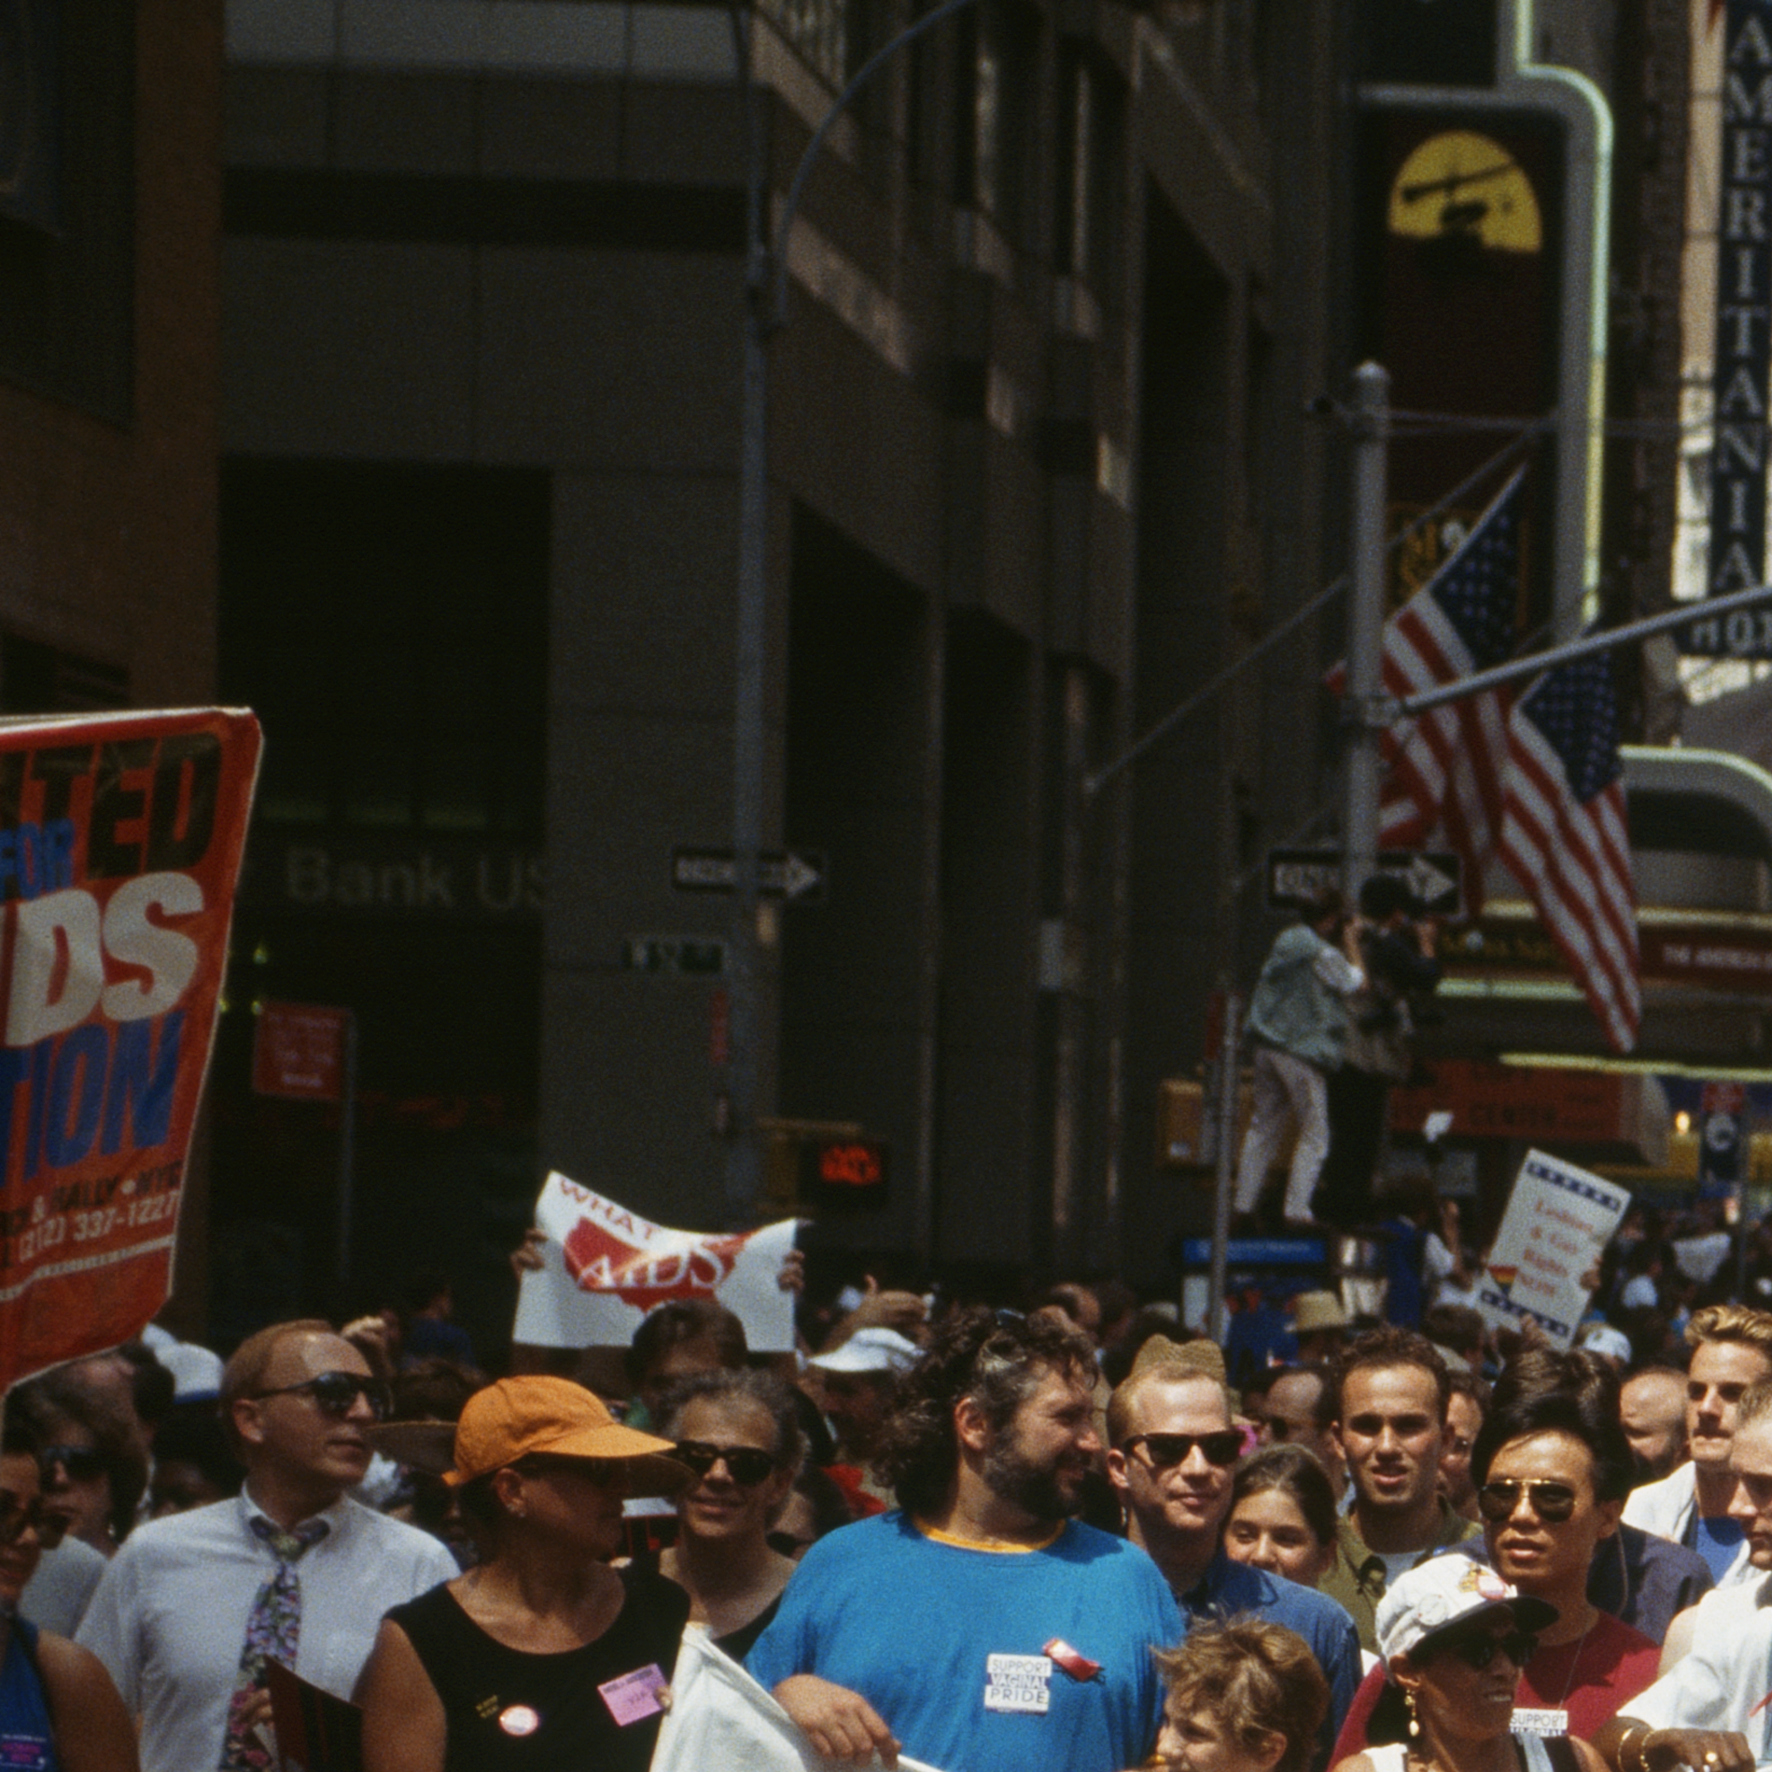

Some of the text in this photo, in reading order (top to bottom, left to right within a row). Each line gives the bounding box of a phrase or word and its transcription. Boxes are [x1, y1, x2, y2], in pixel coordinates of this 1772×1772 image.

[285, 845, 455, 906] Bank
[557, 1178, 659, 1241] WHAT
[19, 1215, 66, 1264] (212)
[577, 1242, 728, 1289] AIDS
[989, 1673, 1047, 1689] VAGINAL
[991, 1659, 1049, 1673] SUPPORT
[989, 1688, 1048, 1704] PRIDE
[1510, 1711, 1567, 1728] SUPPORT
